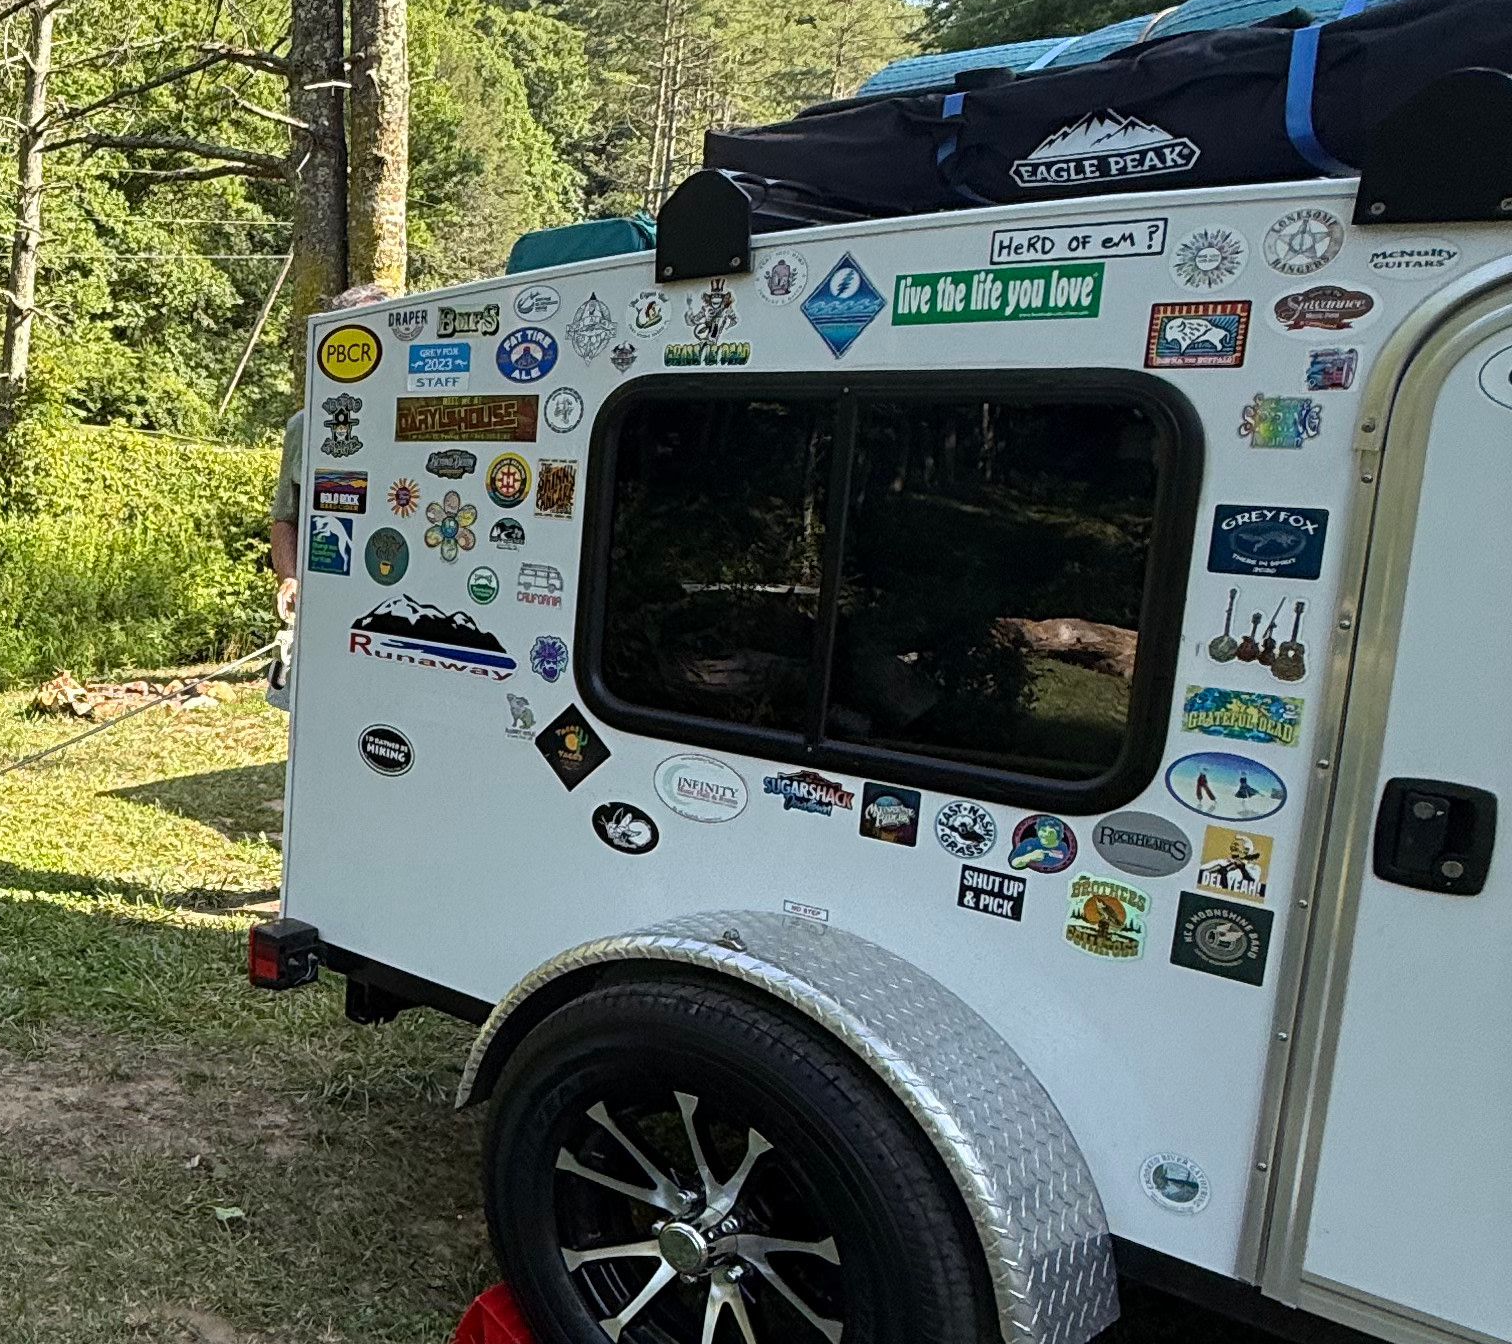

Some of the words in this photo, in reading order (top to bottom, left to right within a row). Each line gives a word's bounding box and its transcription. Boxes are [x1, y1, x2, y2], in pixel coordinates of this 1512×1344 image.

[1018, 157, 1100, 183] EAGLE
[1110, 145, 1187, 175] PEAK
[1067, 234, 1092, 252] OF
[1373, 260, 1445, 269] GUITARS
[897, 276, 931, 314] live
[937, 276, 966, 313] the
[970, 271, 1002, 310] life
[1004, 279, 1045, 316] you
[1048, 270, 1093, 307] love
[388, 309, 428, 327] DRAPER
[503, 332, 523, 351] FAT
[526, 330, 553, 349] TIRE
[326, 343, 372, 363] PBCR
[419, 348, 441, 358] GREY
[442, 347, 459, 356] FOX
[424, 358, 452, 372] 2023
[510, 367, 541, 380] ALE
[416, 377, 460, 388] STAFF
[1221, 509, 1277, 530] GREY
[1278, 511, 1319, 535] FOX
[516, 591, 562, 607] CALIFORNIA
[349, 632, 513, 682] Runaway
[1188, 711, 1254, 730] GRATEFUL
[1258, 716, 1294, 743] DEAD
[366, 742, 406, 762] HIKING
[678, 776, 737, 798] INFINITY
[763, 776, 855, 810] SUGARSHACK
[938, 804, 963, 827] EAST
[968, 805, 993, 837] NASH
[940, 833, 984, 856] GRASS
[963, 870, 1002, 893] SHUT
[1003, 878, 1024, 897] UP
[1071, 877, 1146, 912] BROTHERS
[1201, 872, 1223, 889] DEL
[1227, 876, 1262, 897] YEAH!
[963, 890, 977, 908] &
[979, 894, 1015, 917] PICK
[1190, 909, 1253, 931] MOONSHINE
[1247, 932, 1260, 959] BAND
